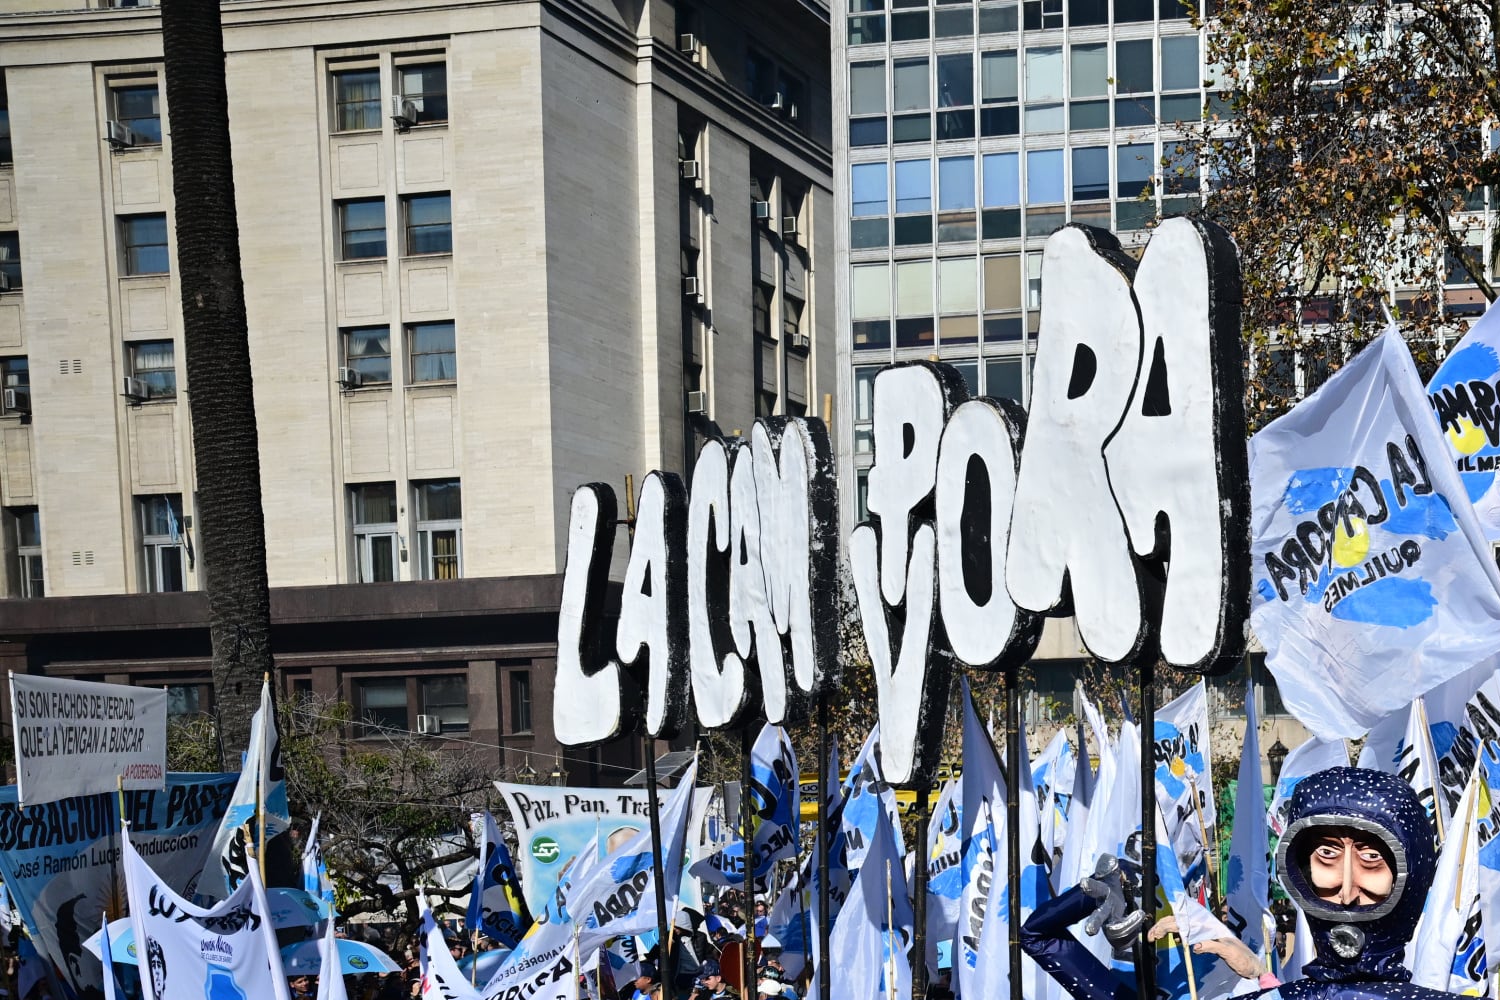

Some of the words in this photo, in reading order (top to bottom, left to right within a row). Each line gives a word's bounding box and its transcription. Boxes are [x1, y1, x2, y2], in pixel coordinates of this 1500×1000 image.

[17, 690, 28, 719] SI
[29, 692, 50, 720] SON
[52, 693, 88, 720] FACHOS
[90, 695, 101, 720] DE
[20, 726, 43, 758] QUE
[46, 728, 59, 755] LA
[61, 728, 100, 755] VENGAN
[109, 728, 145, 753] BUSCAR
[129, 764, 162, 780] PODEROSA
[510, 791, 559, 829] Paz,
[564, 794, 609, 815] Pan,
[13, 857, 40, 879] José
[43, 849, 87, 875] Ramón
